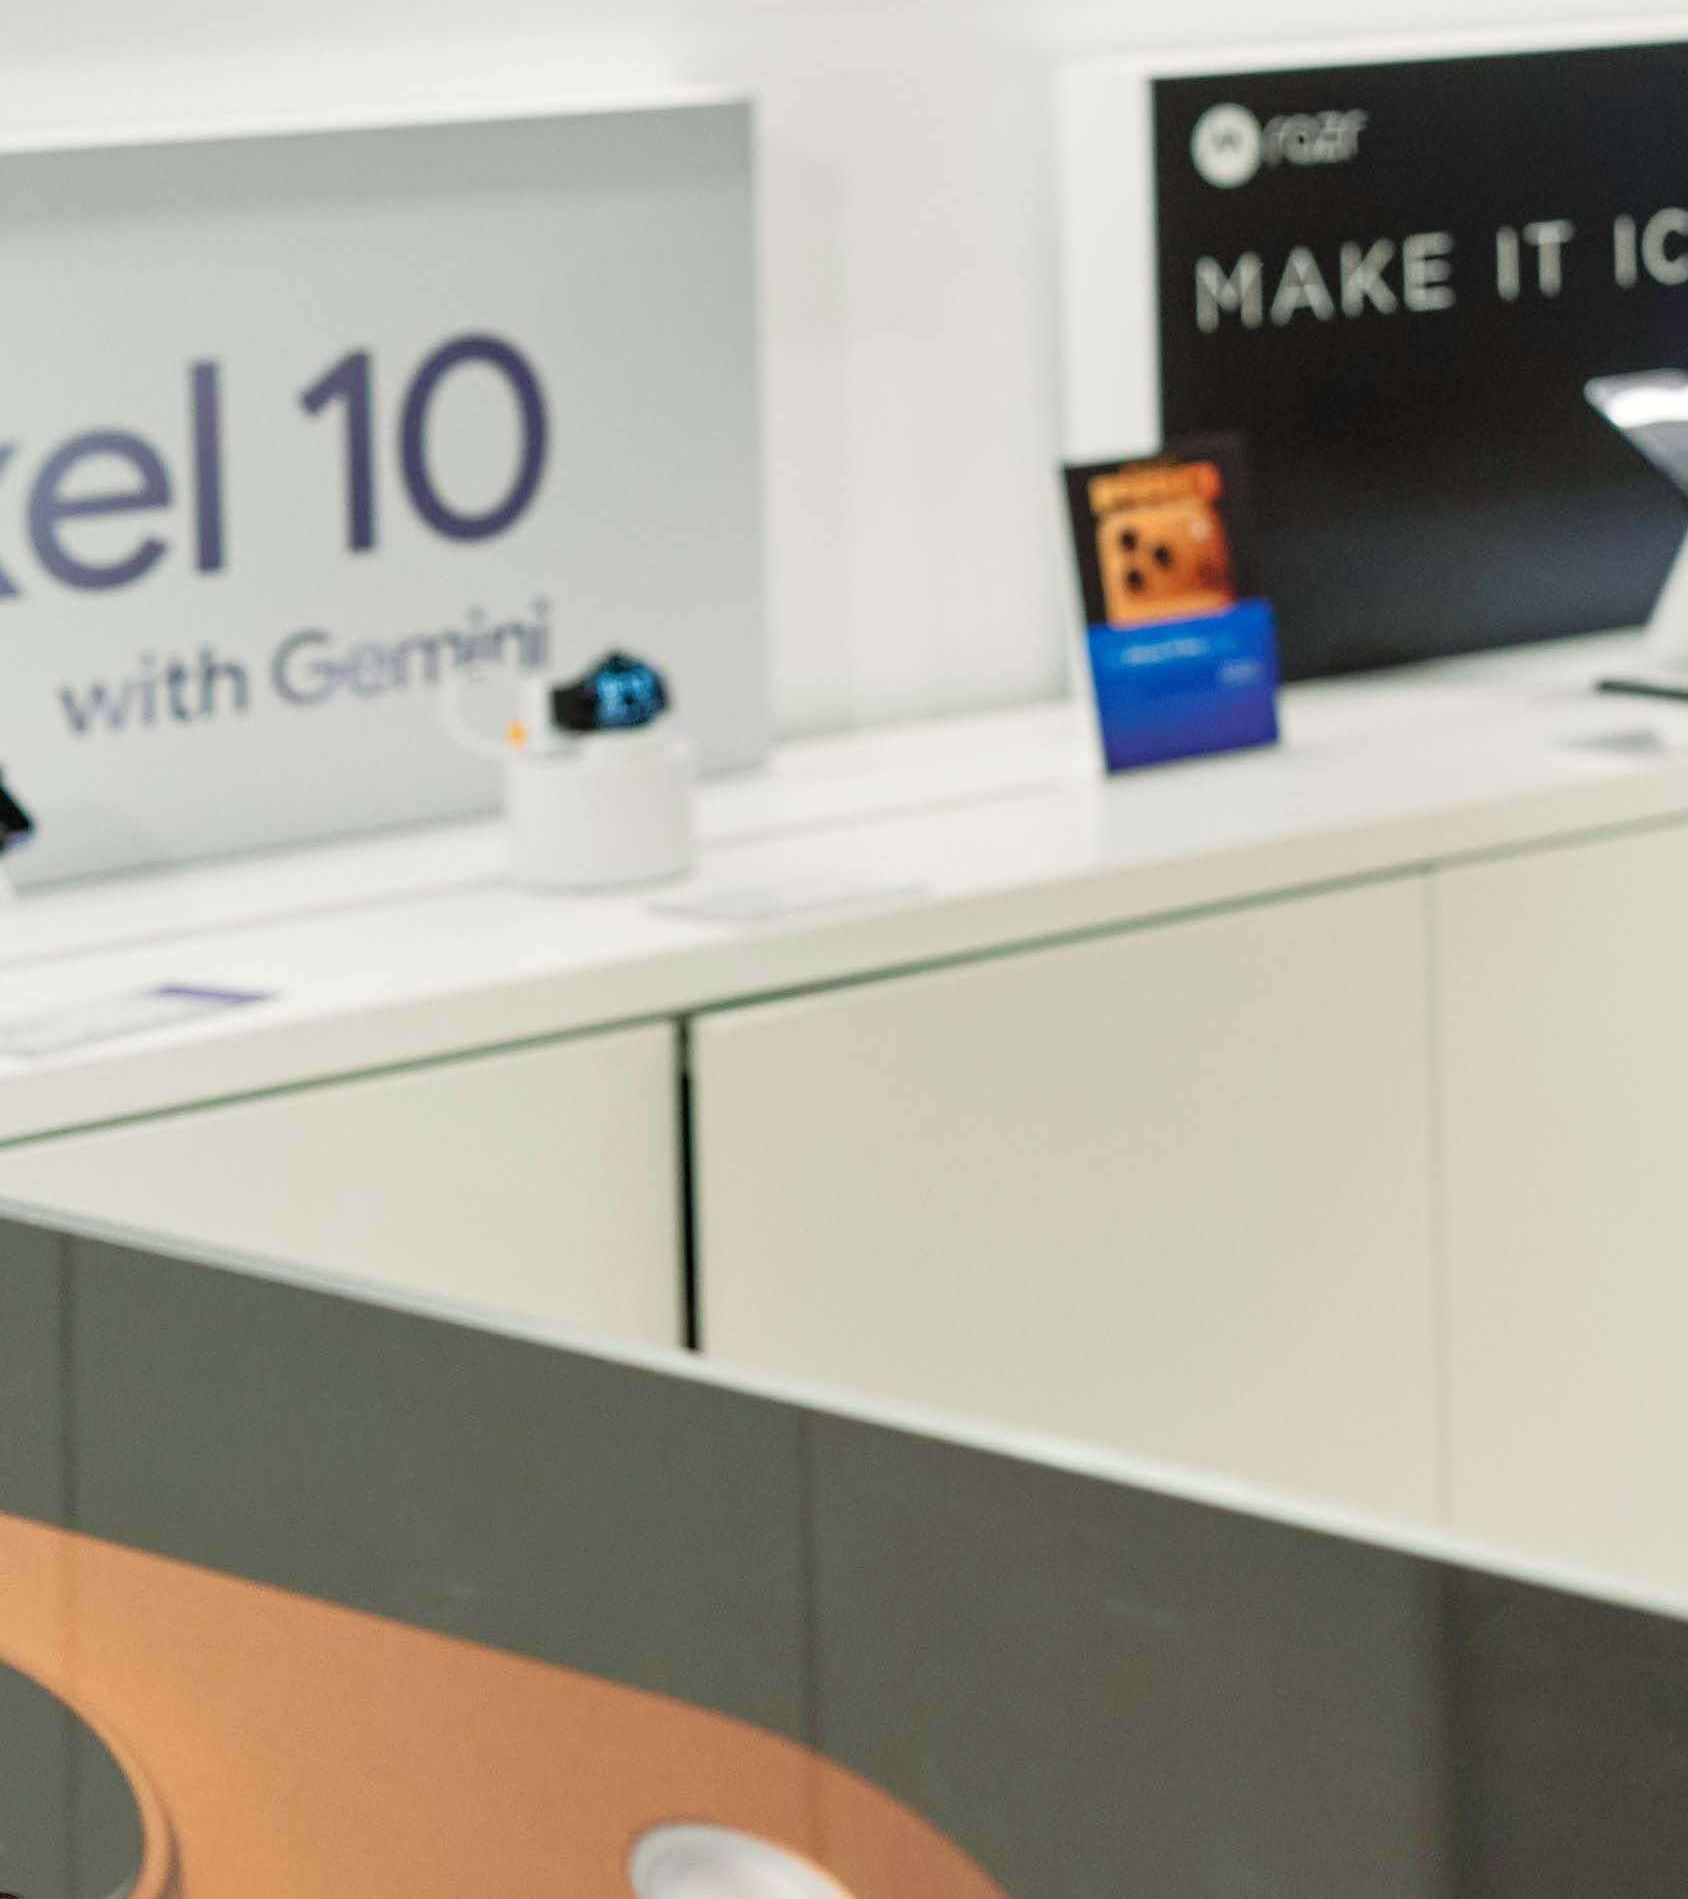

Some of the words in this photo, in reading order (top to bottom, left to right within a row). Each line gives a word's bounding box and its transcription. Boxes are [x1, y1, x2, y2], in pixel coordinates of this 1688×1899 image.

[1195, 230, 1457, 334] MAKE
[1495, 217, 1577, 302] IT
[298, 331, 550, 554] 10
[57, 641, 252, 737] with
[267, 596, 553, 709] Gemini
